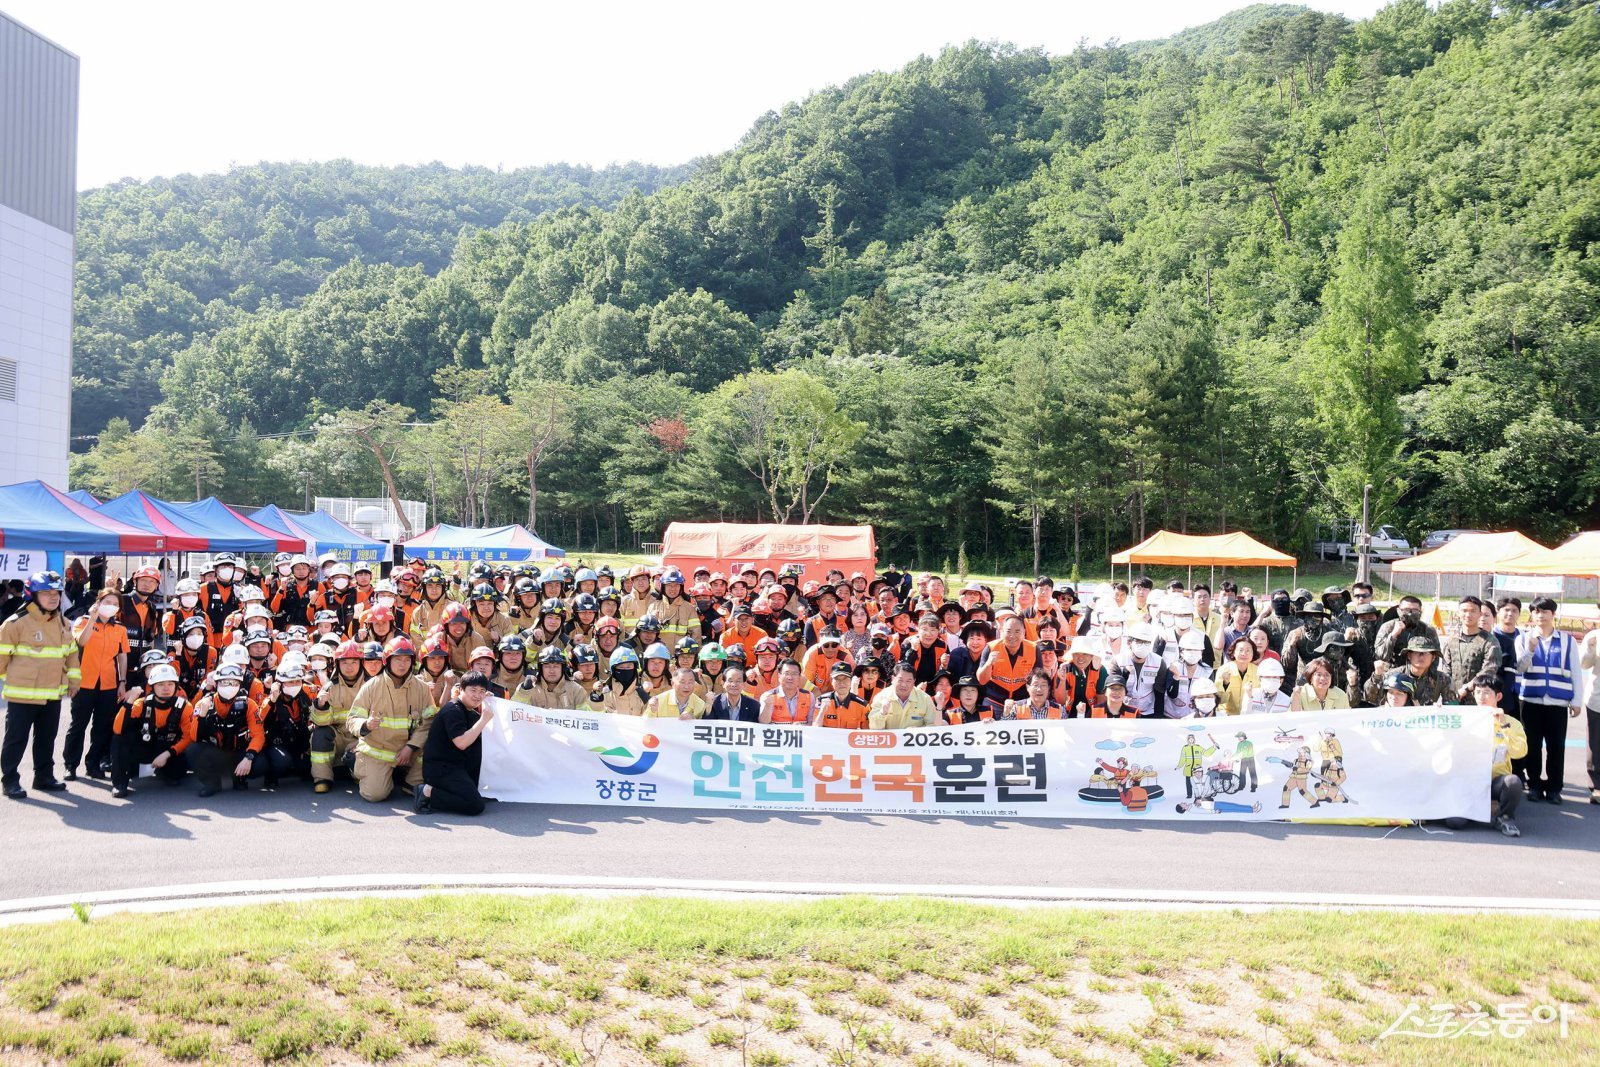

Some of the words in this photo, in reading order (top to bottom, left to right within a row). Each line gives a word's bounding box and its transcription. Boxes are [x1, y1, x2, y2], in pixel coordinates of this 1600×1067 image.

[693, 725, 755, 747] 국민과
[763, 726, 803, 748] 함께
[853, 733, 891, 747] 상반기
[903, 732, 959, 747] 2026.
[964, 732, 981, 746] 5.
[986, 730, 1046, 746] 29.(금)
[596, 780, 657, 802] 장흥군
